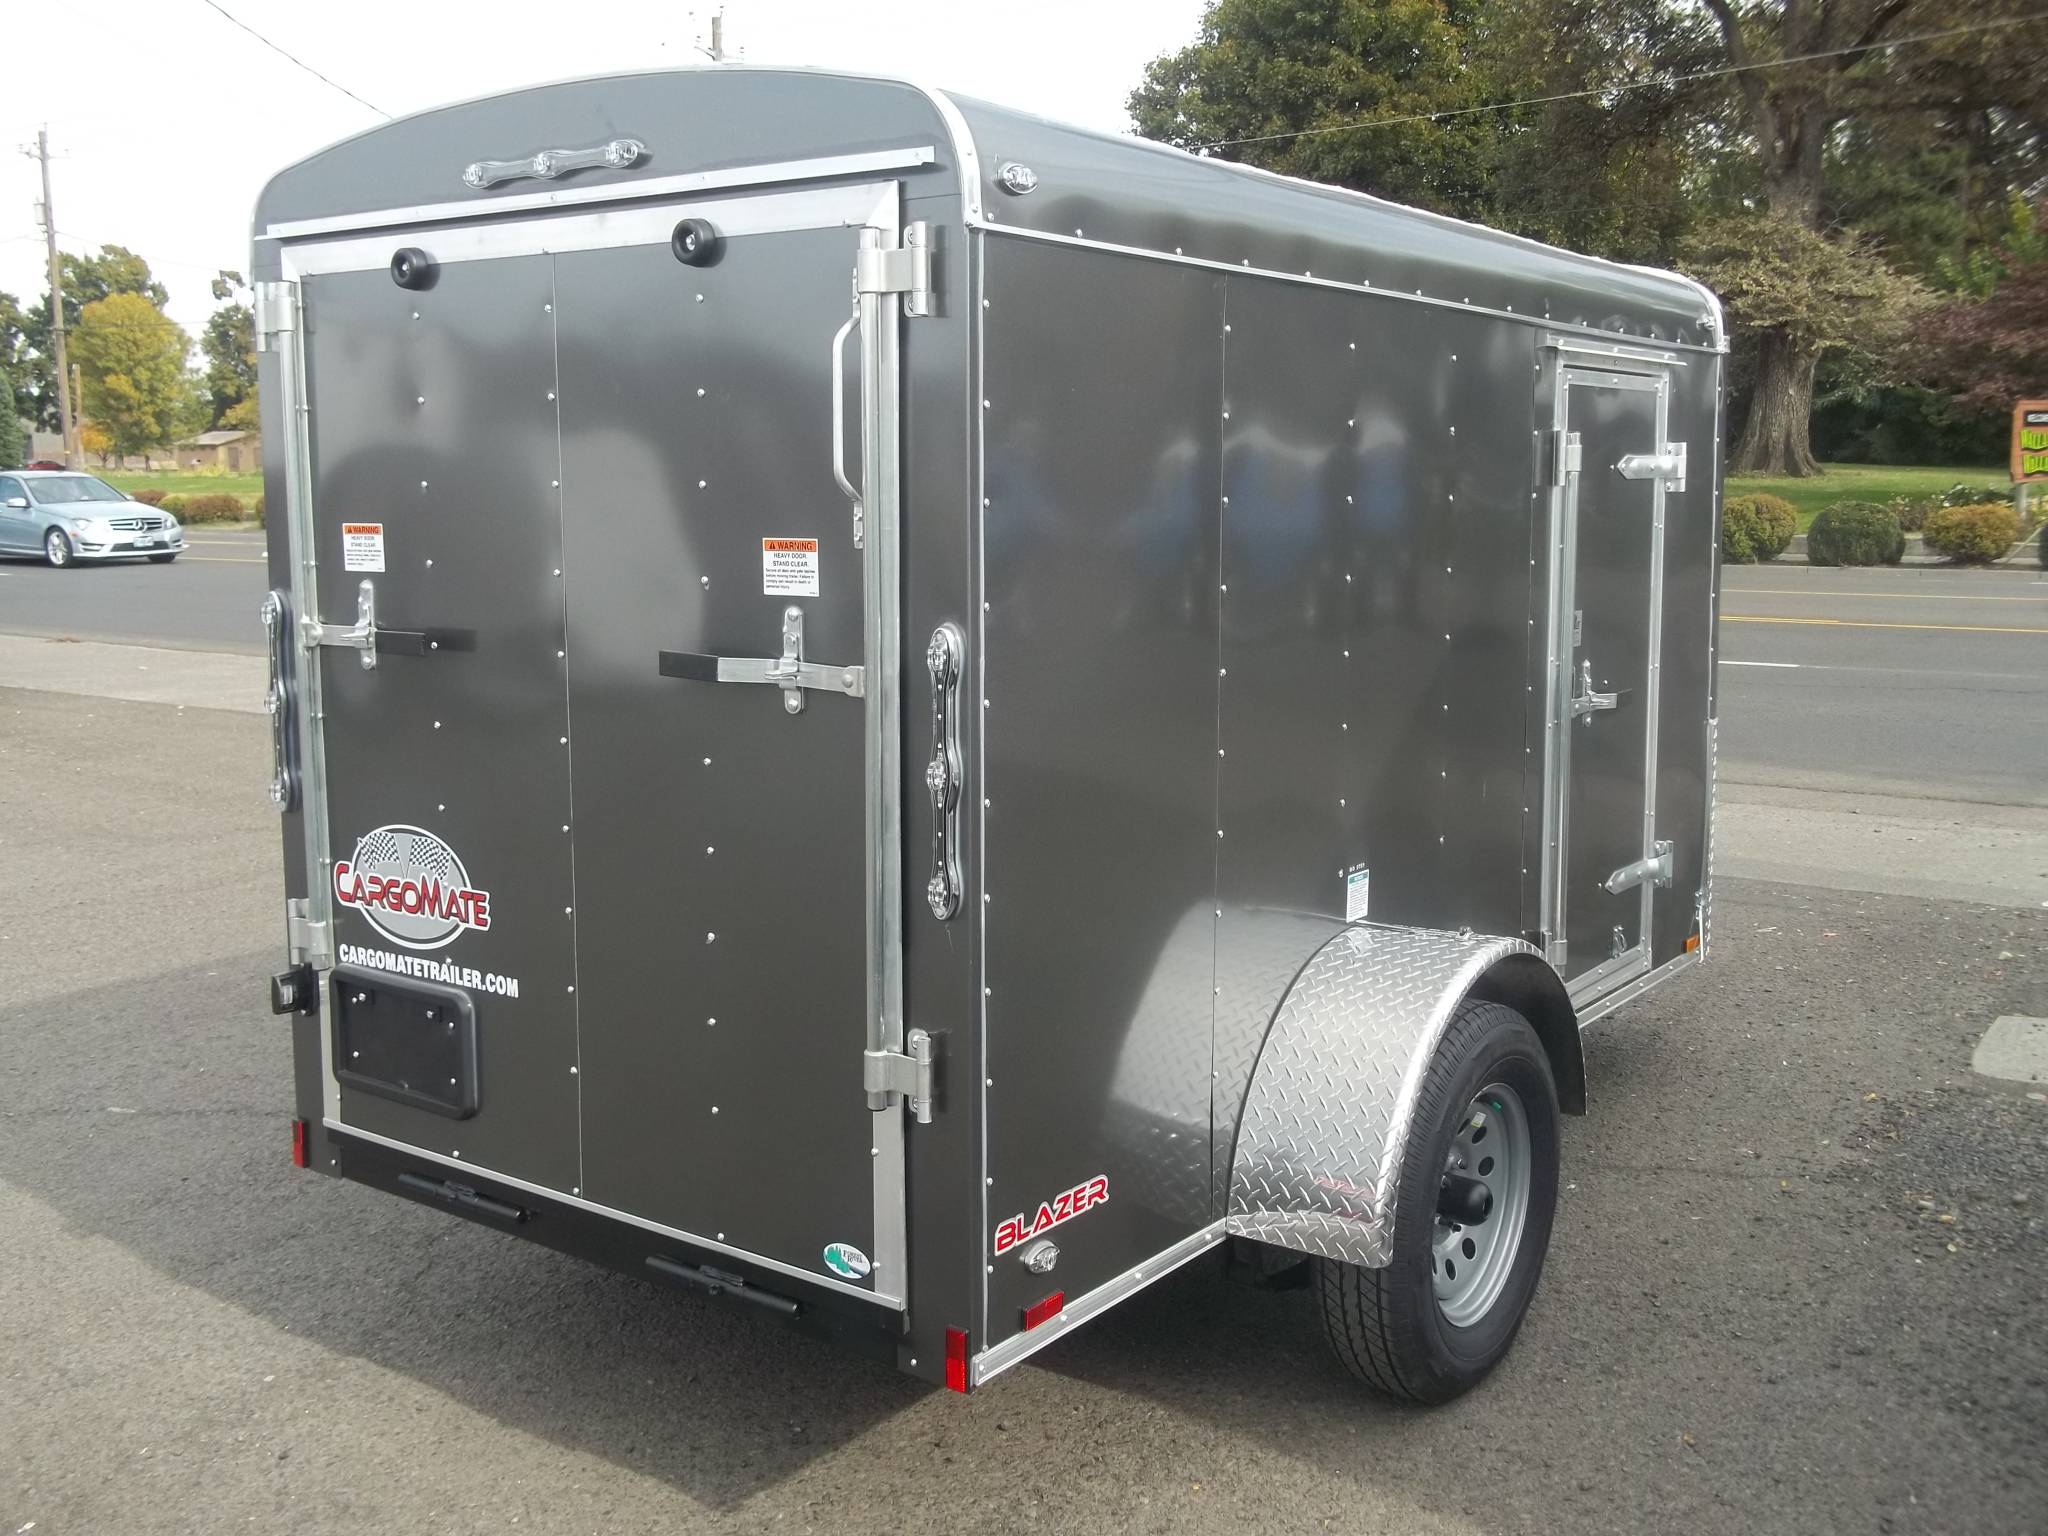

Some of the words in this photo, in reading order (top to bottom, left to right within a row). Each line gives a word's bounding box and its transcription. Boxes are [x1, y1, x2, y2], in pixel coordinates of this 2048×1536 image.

[352, 525, 379, 534] WARNING
[777, 541, 813, 551] WARNING
[335, 861, 490, 930] CARGOMATE
[339, 943, 519, 998] CARGOMATETRAILER.COM
[996, 1176, 1108, 1254] BLAZER
